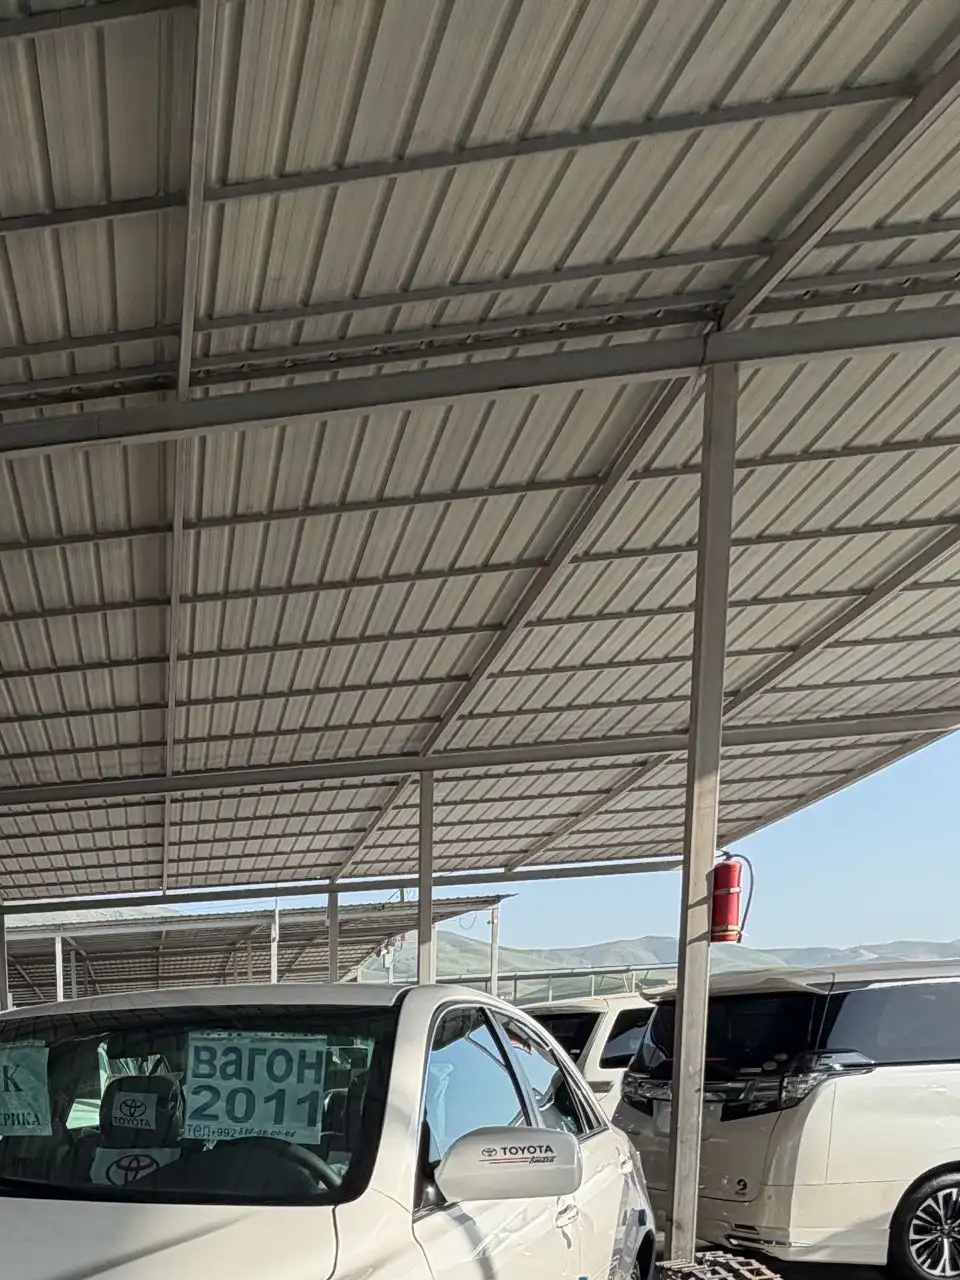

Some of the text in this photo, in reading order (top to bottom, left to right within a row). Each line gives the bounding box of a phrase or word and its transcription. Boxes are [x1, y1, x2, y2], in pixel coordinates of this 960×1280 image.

[191, 1045, 323, 1084] Вагон
[187, 1085, 320, 1128] 2011
[112, 1116, 152, 1129] TOYOTA
[500, 1145, 555, 1156] TOYOTA
